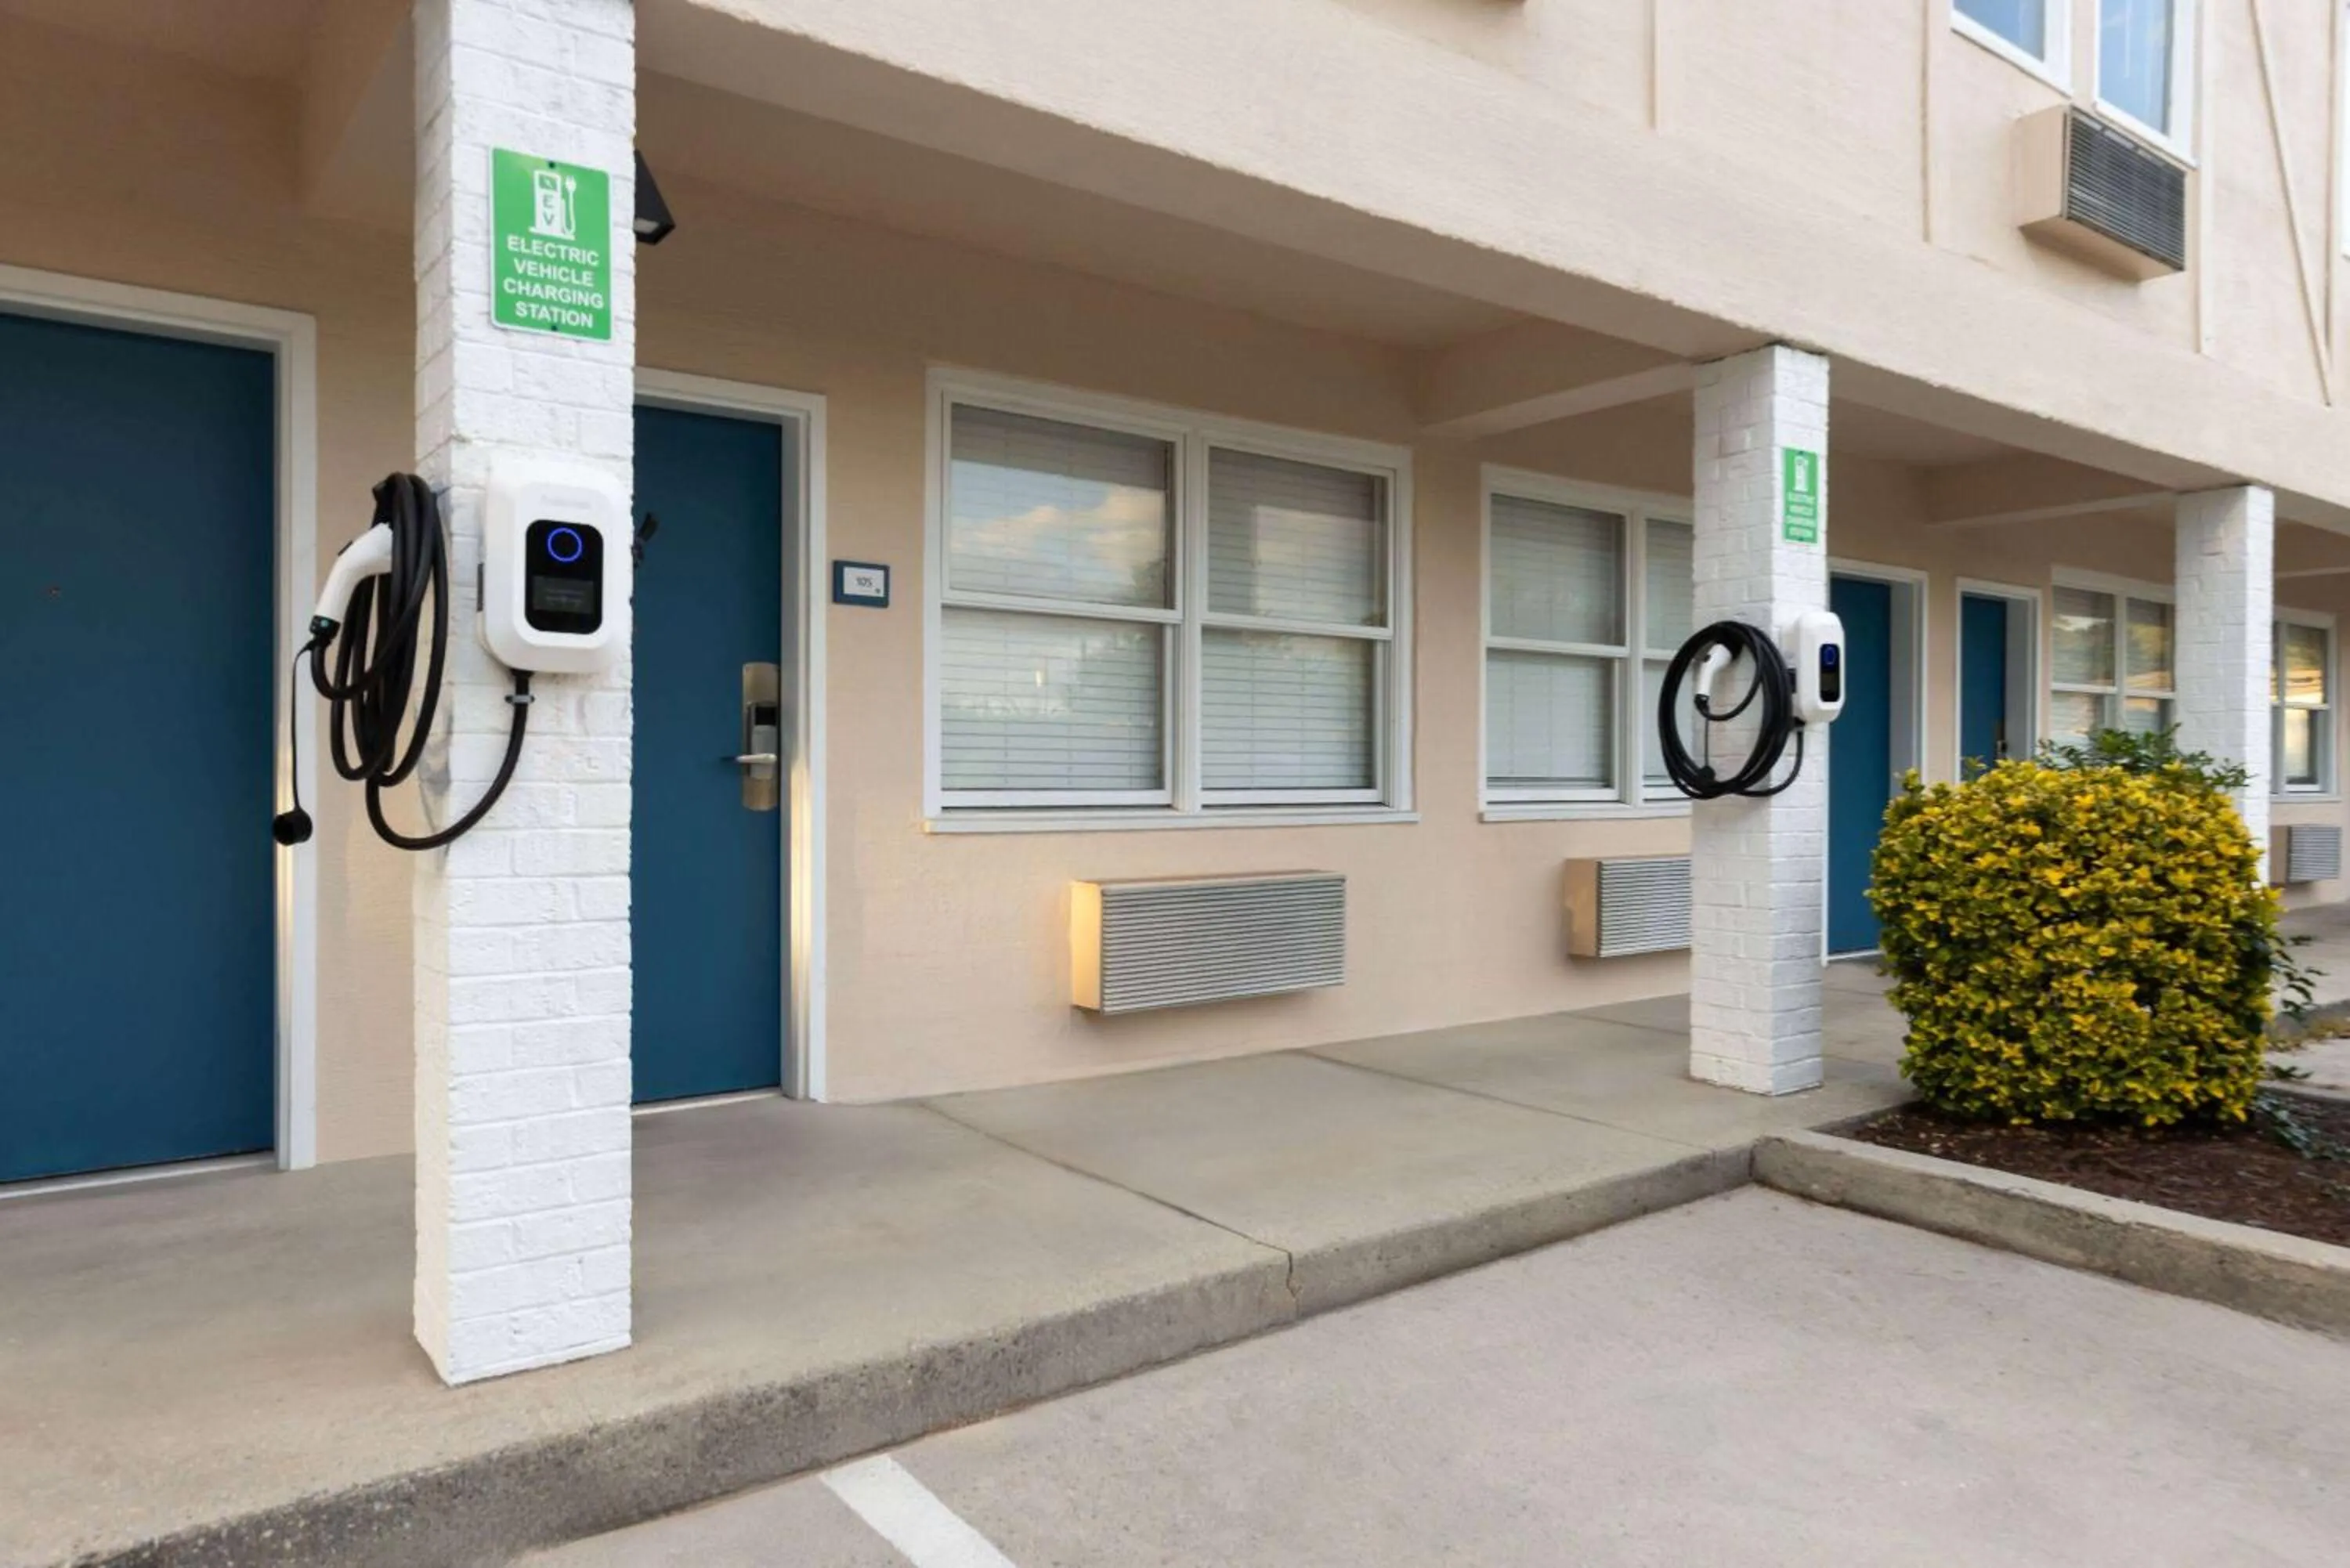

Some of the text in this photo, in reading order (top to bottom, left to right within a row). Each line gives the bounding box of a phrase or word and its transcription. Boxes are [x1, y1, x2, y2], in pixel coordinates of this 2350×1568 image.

[508, 236, 598, 266] ELECTRIC
[515, 260, 593, 287] VEHICLE
[504, 278, 603, 308] CHARGING
[515, 302, 593, 327] STATION
